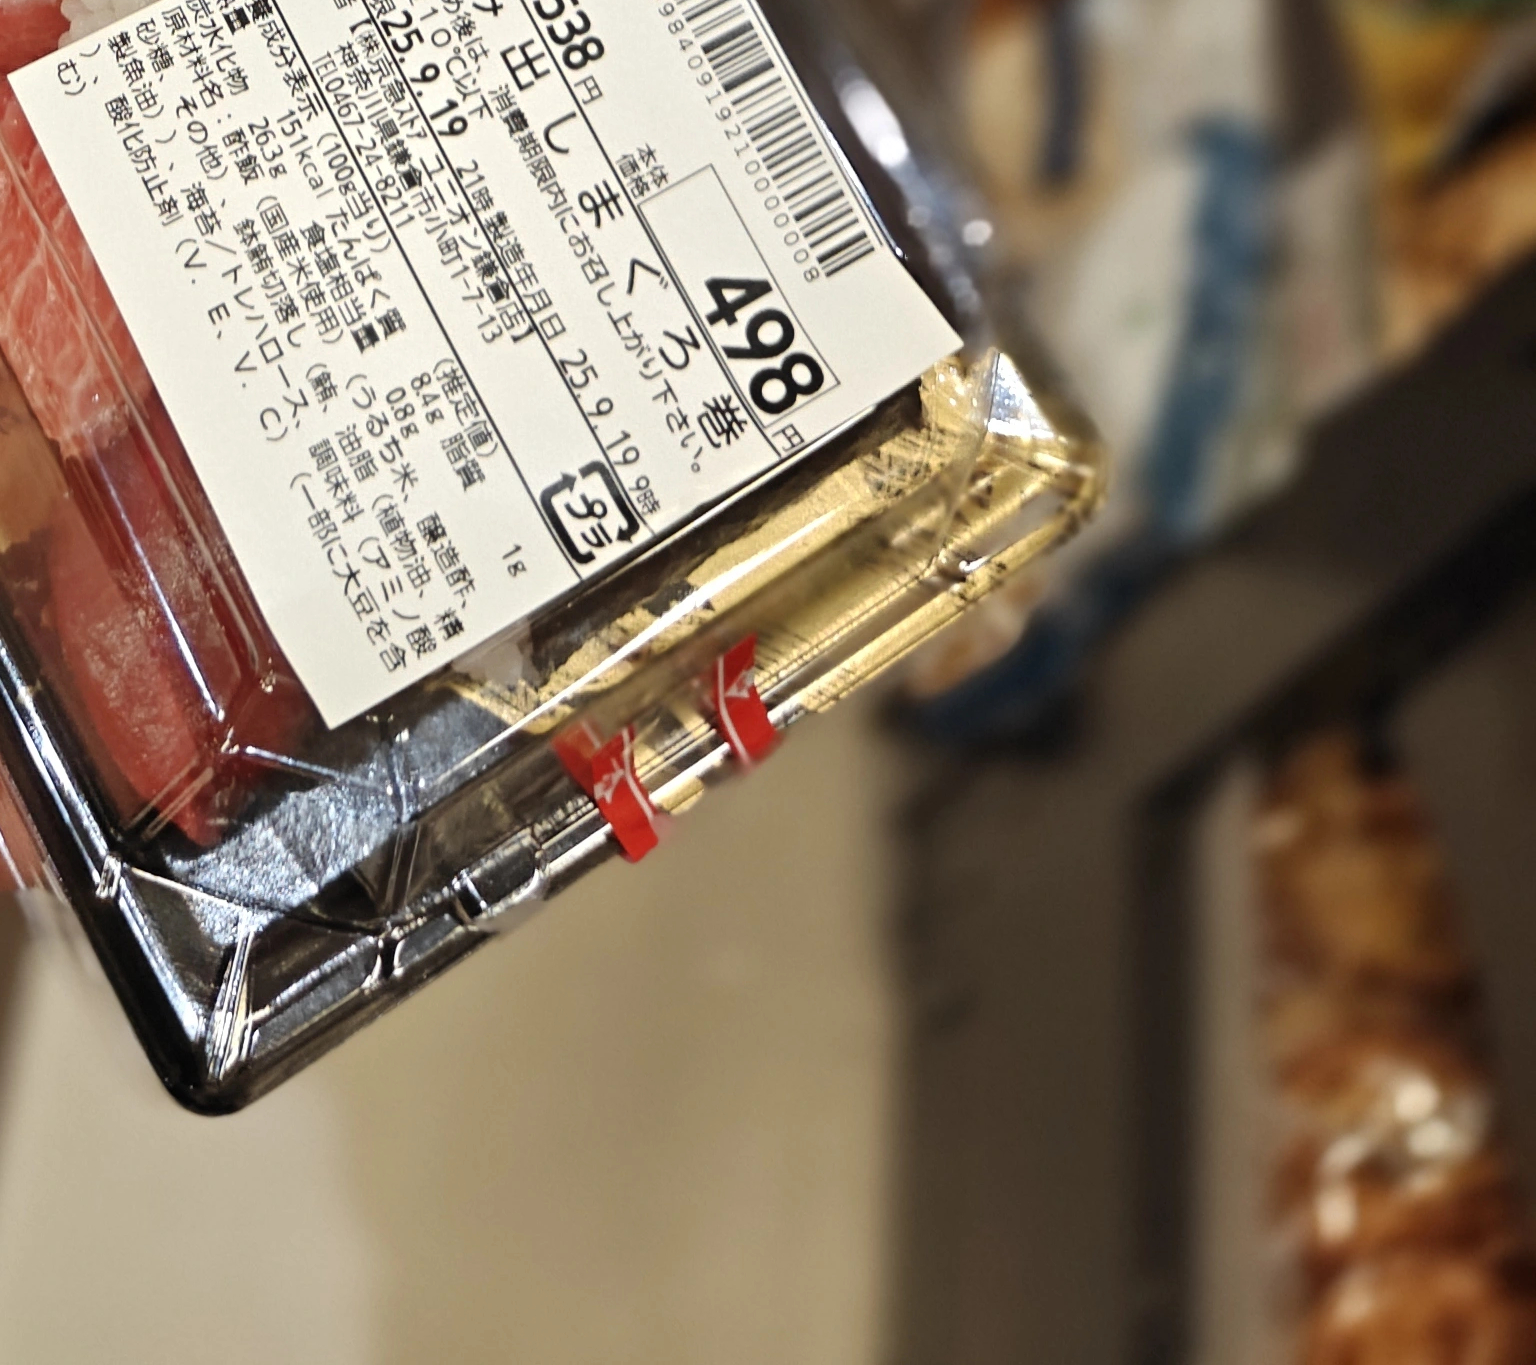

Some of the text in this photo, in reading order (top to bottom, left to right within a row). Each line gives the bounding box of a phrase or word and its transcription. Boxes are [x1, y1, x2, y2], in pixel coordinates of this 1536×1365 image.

[573, 74, 603, 105] 円
[636, 143, 668, 188] 本体
[247, 115, 287, 179] 26.3g
[298, 219, 379, 354] 食塩相当量
[385, 386, 419, 439] 0.8g
[276, 108, 334, 198] 151kcal
[324, 206, 406, 340] たんぱく質
[410, 371, 444, 425] 8.4g
[439, 432, 485, 492] 脂質
[452, 158, 494, 217] 21時
[479, 210, 566, 344] 製造年月日
[616, 153, 824, 460] 価格 498 円
[563, 492, 626, 558] プラ
